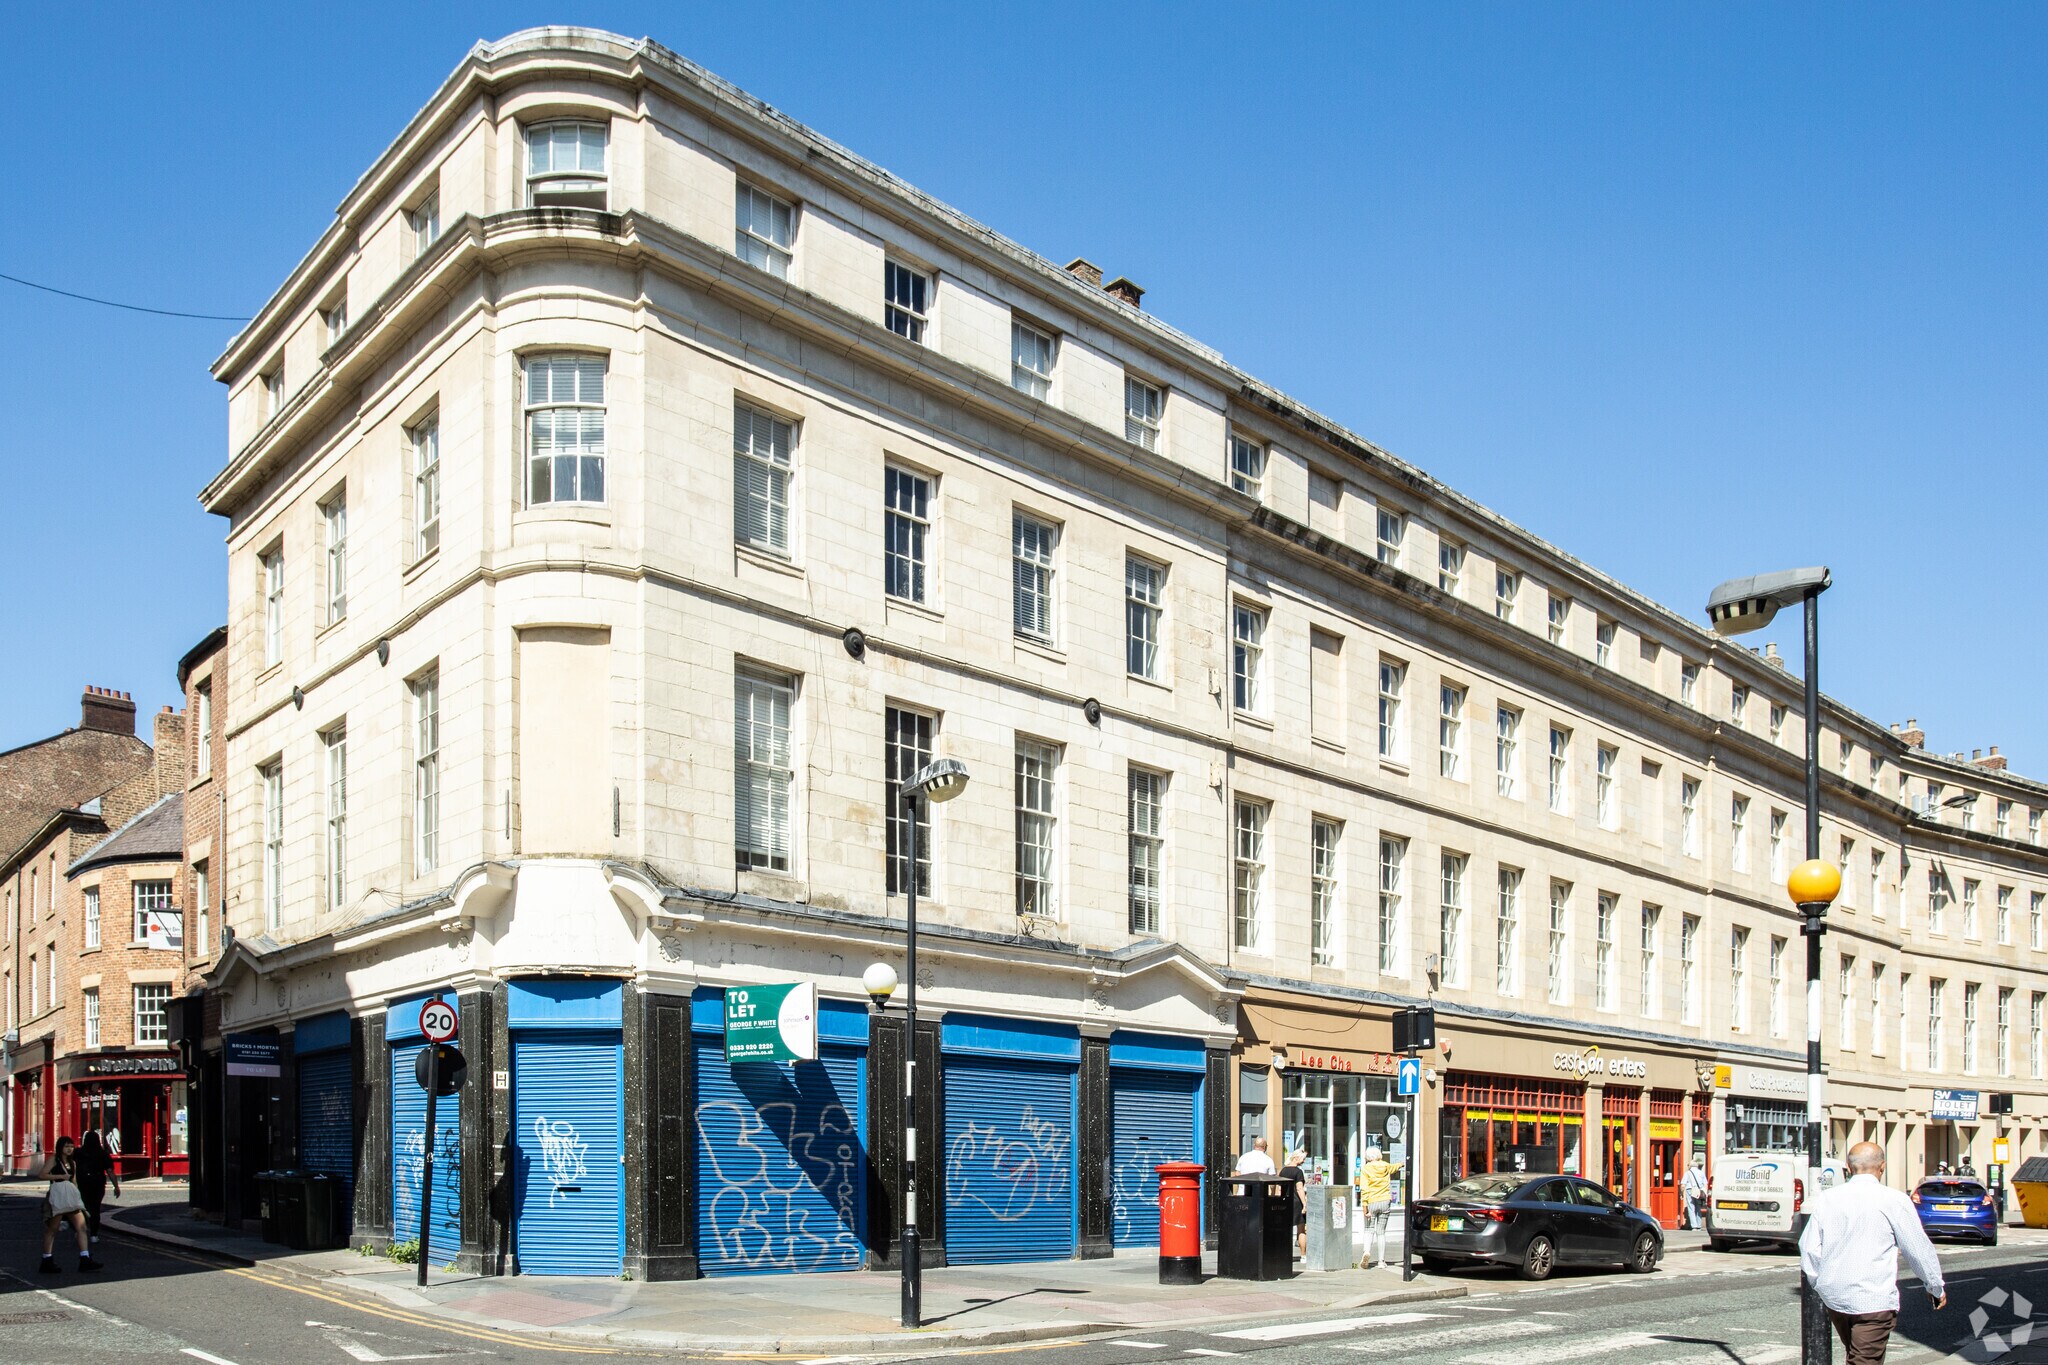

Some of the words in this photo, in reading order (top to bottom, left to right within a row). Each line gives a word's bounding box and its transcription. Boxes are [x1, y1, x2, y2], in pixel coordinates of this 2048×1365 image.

[728, 991, 749, 1004] TO
[729, 1004, 757, 1018] LET
[426, 1012, 452, 1031] 20
[745, 1043, 758, 1051] 920
[758, 1042, 774, 1050] 2220
[1300, 1050, 1323, 1068] Lee
[1330, 1055, 1352, 1071] Cha
[1553, 1050, 1581, 1071] cash
[1749, 1071, 1766, 1090] Cats
[1768, 1073, 1806, 1094] Protection
[1934, 1090, 1951, 1100] SW
[1654, 1124, 1678, 1132] converters
